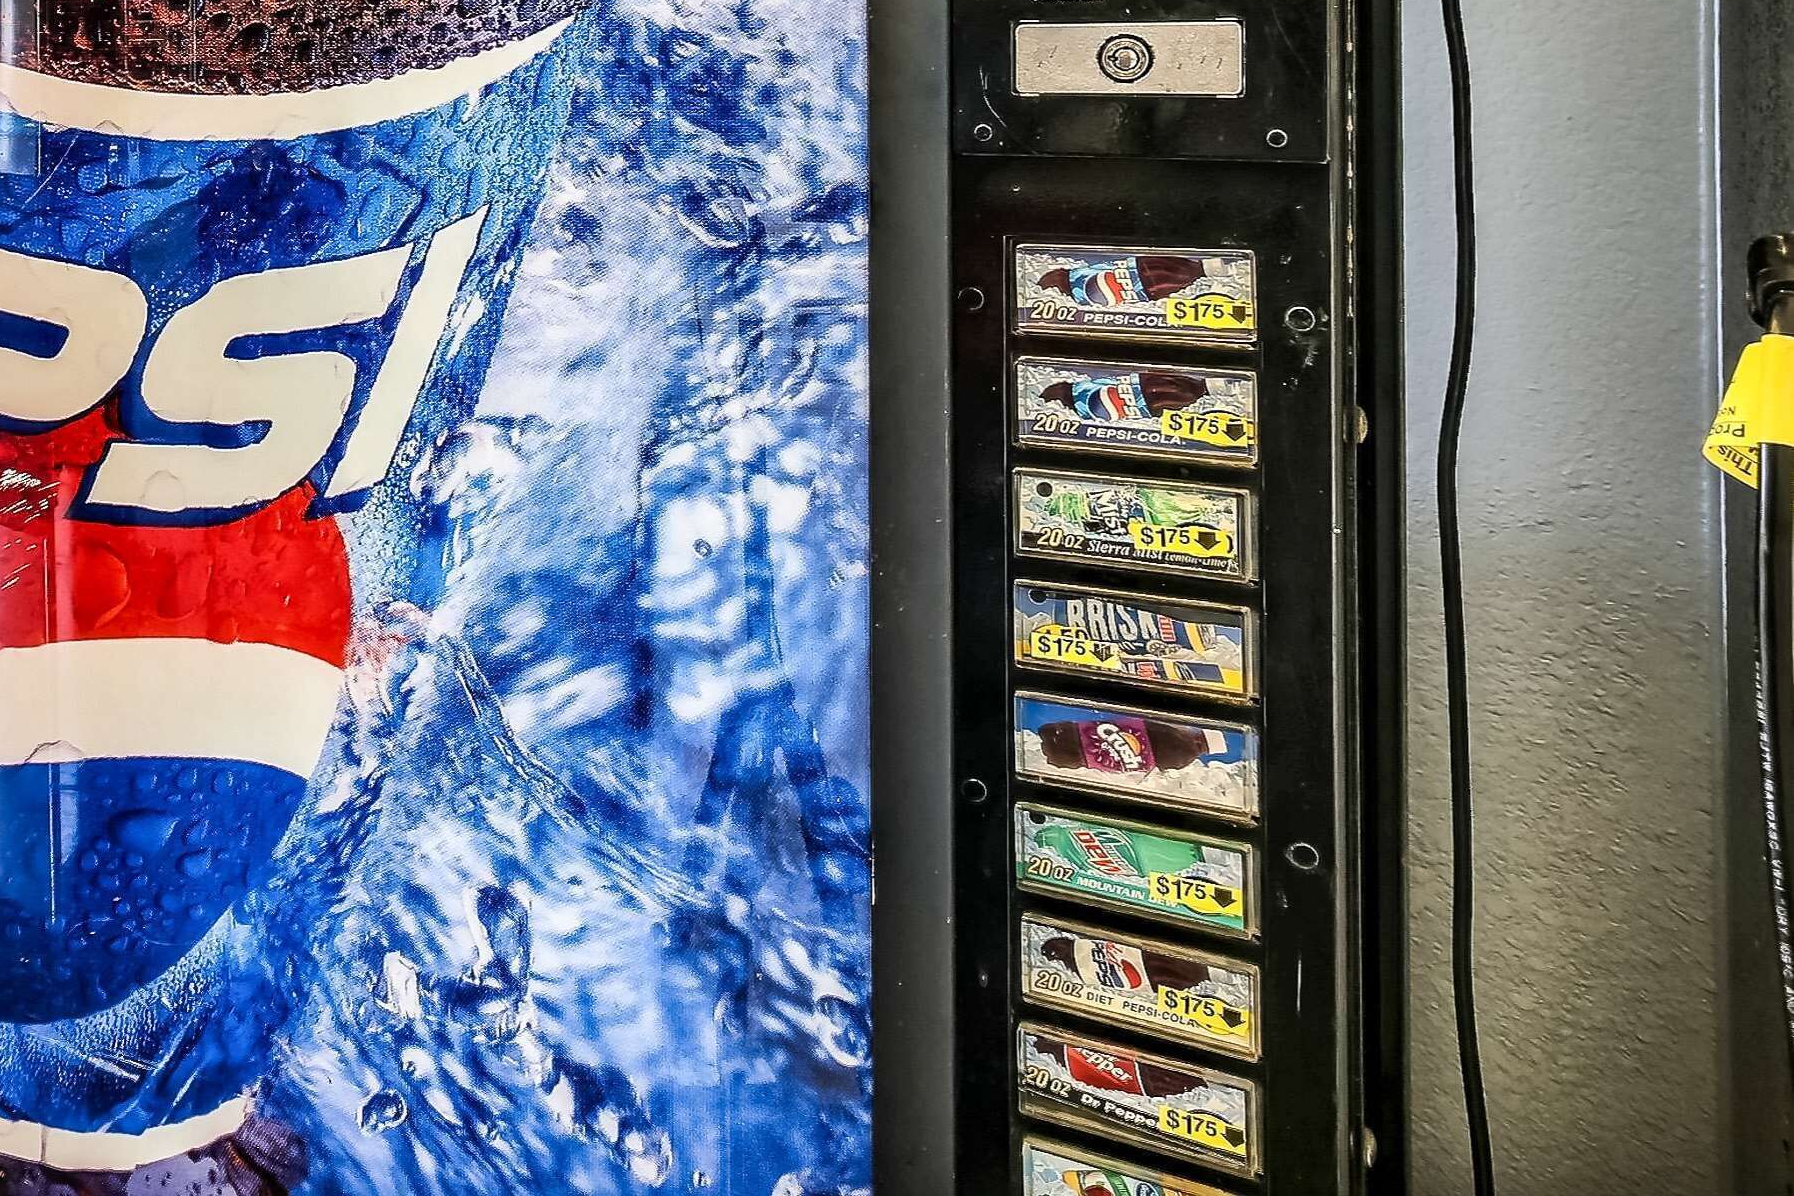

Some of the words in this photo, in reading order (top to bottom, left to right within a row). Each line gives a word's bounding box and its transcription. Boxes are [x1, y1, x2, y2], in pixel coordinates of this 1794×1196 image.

[1031, 300, 1055, 321] 20
[1033, 413, 1057, 434] 20
[1718, 445, 1753, 476] This
[1037, 527, 1061, 546] 20
[1087, 540, 1130, 557] Sierra
[1027, 857, 1051, 877] 20
[1077, 876, 1146, 901] MOUNTAIN
[1035, 970, 1062, 992] 20
[1086, 991, 1114, 1006] DIET
[1027, 1066, 1051, 1088] 20
[1080, 1093, 1101, 1110] Dr
